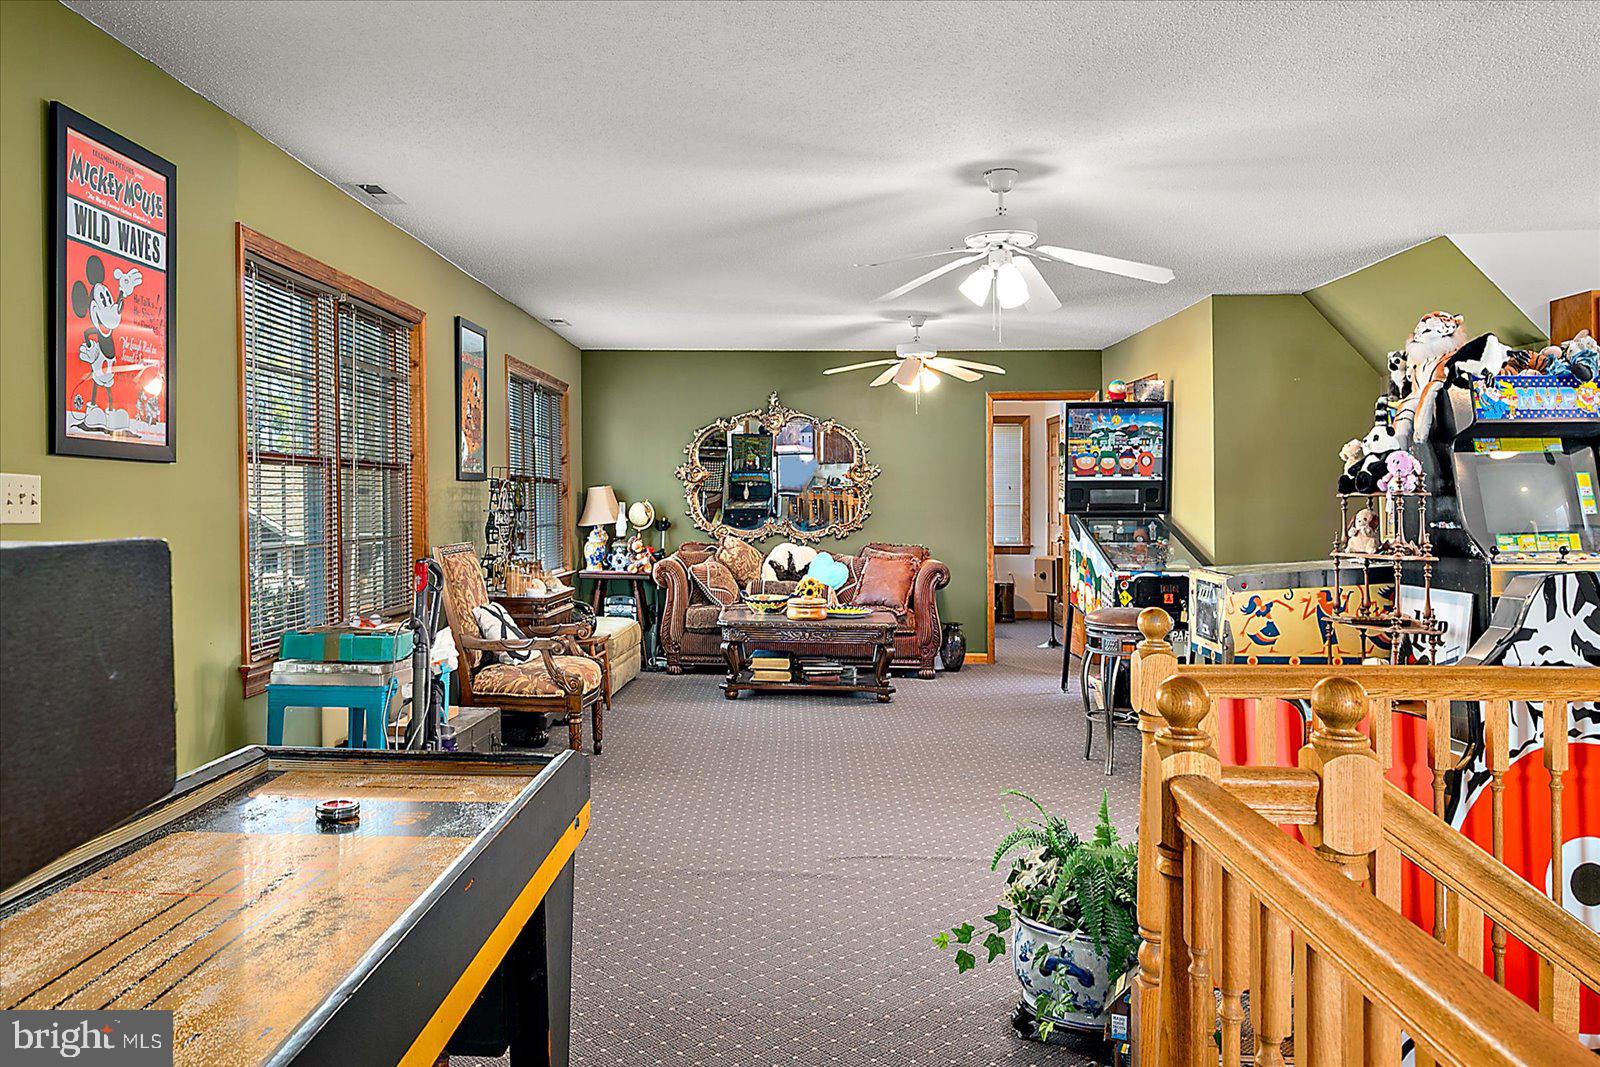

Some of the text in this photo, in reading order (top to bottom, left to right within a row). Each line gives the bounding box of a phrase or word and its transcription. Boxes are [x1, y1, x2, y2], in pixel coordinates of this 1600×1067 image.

[69, 148, 124, 202] MICKEY
[123, 175, 164, 218] MOUSE
[74, 203, 110, 246] WILD
[117, 220, 161, 264] WAVES
